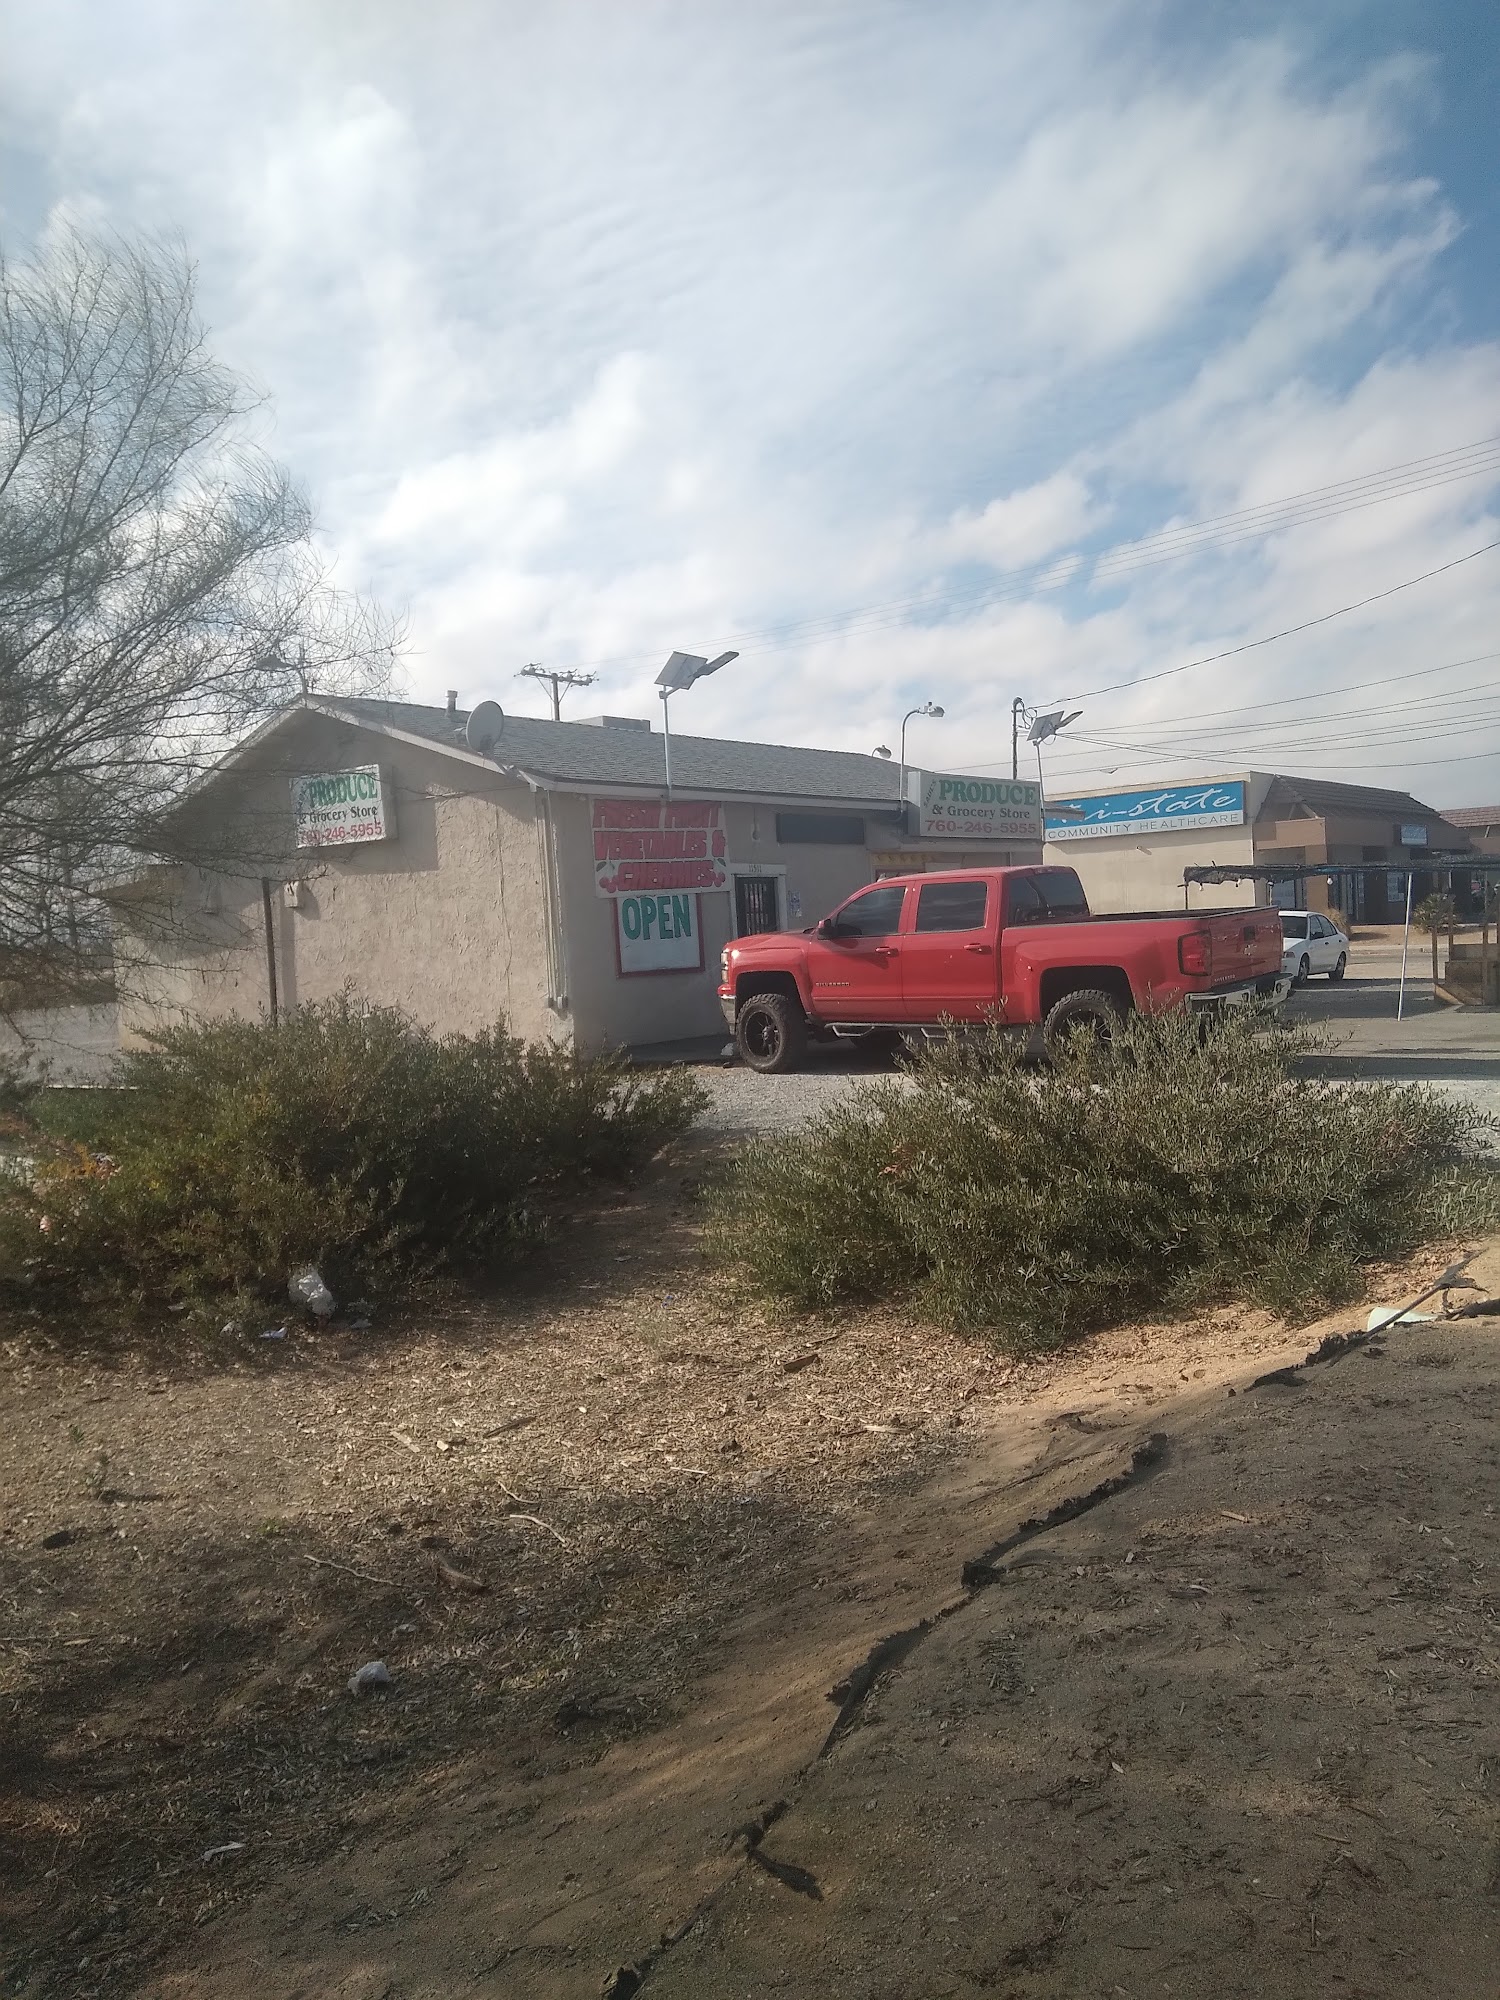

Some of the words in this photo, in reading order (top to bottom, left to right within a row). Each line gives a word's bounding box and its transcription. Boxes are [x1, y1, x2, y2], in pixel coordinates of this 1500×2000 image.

[308, 774, 378, 808] PRODUCE
[938, 779, 1037, 807] PRODUCE
[298, 814, 307, 825] &
[309, 809, 347, 824] Grocery
[350, 805, 379, 819] Store
[932, 803, 944, 815] &
[946, 805, 997, 820] Grocery
[999, 807, 1031, 819] Store
[924, 819, 1038, 834] 760-246-5955
[1047, 823, 1133, 840] COMMUNITY
[1139, 813, 1240, 832] HEALTHCARE
[621, 894, 693, 941] OPEN
